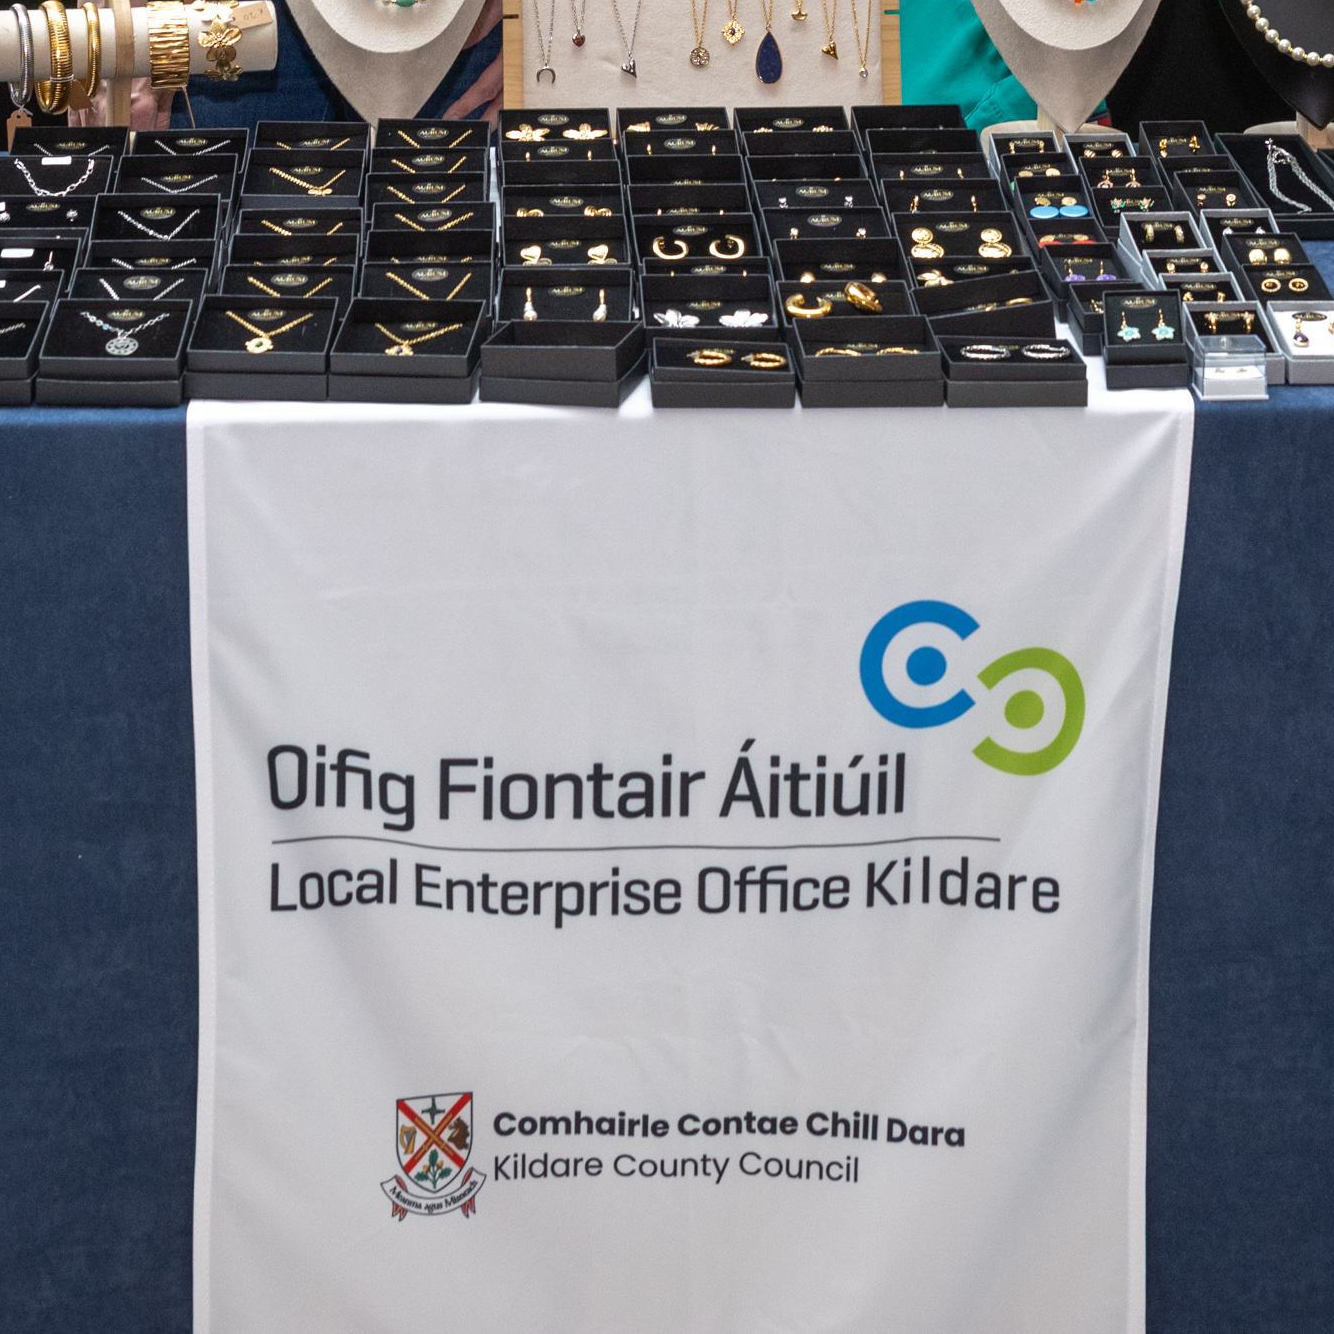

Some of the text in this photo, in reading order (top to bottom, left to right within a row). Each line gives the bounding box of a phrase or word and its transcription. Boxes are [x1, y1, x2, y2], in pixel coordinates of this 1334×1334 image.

[267, 739, 907, 833] Oifig Fiontair Áitiúil
[271, 857, 1061, 930] Local Enterprise Office Kildare
[494, 1111, 966, 1148] Comhairle Contae Chill Dara
[495, 1152, 860, 1186] Kildare County Council
